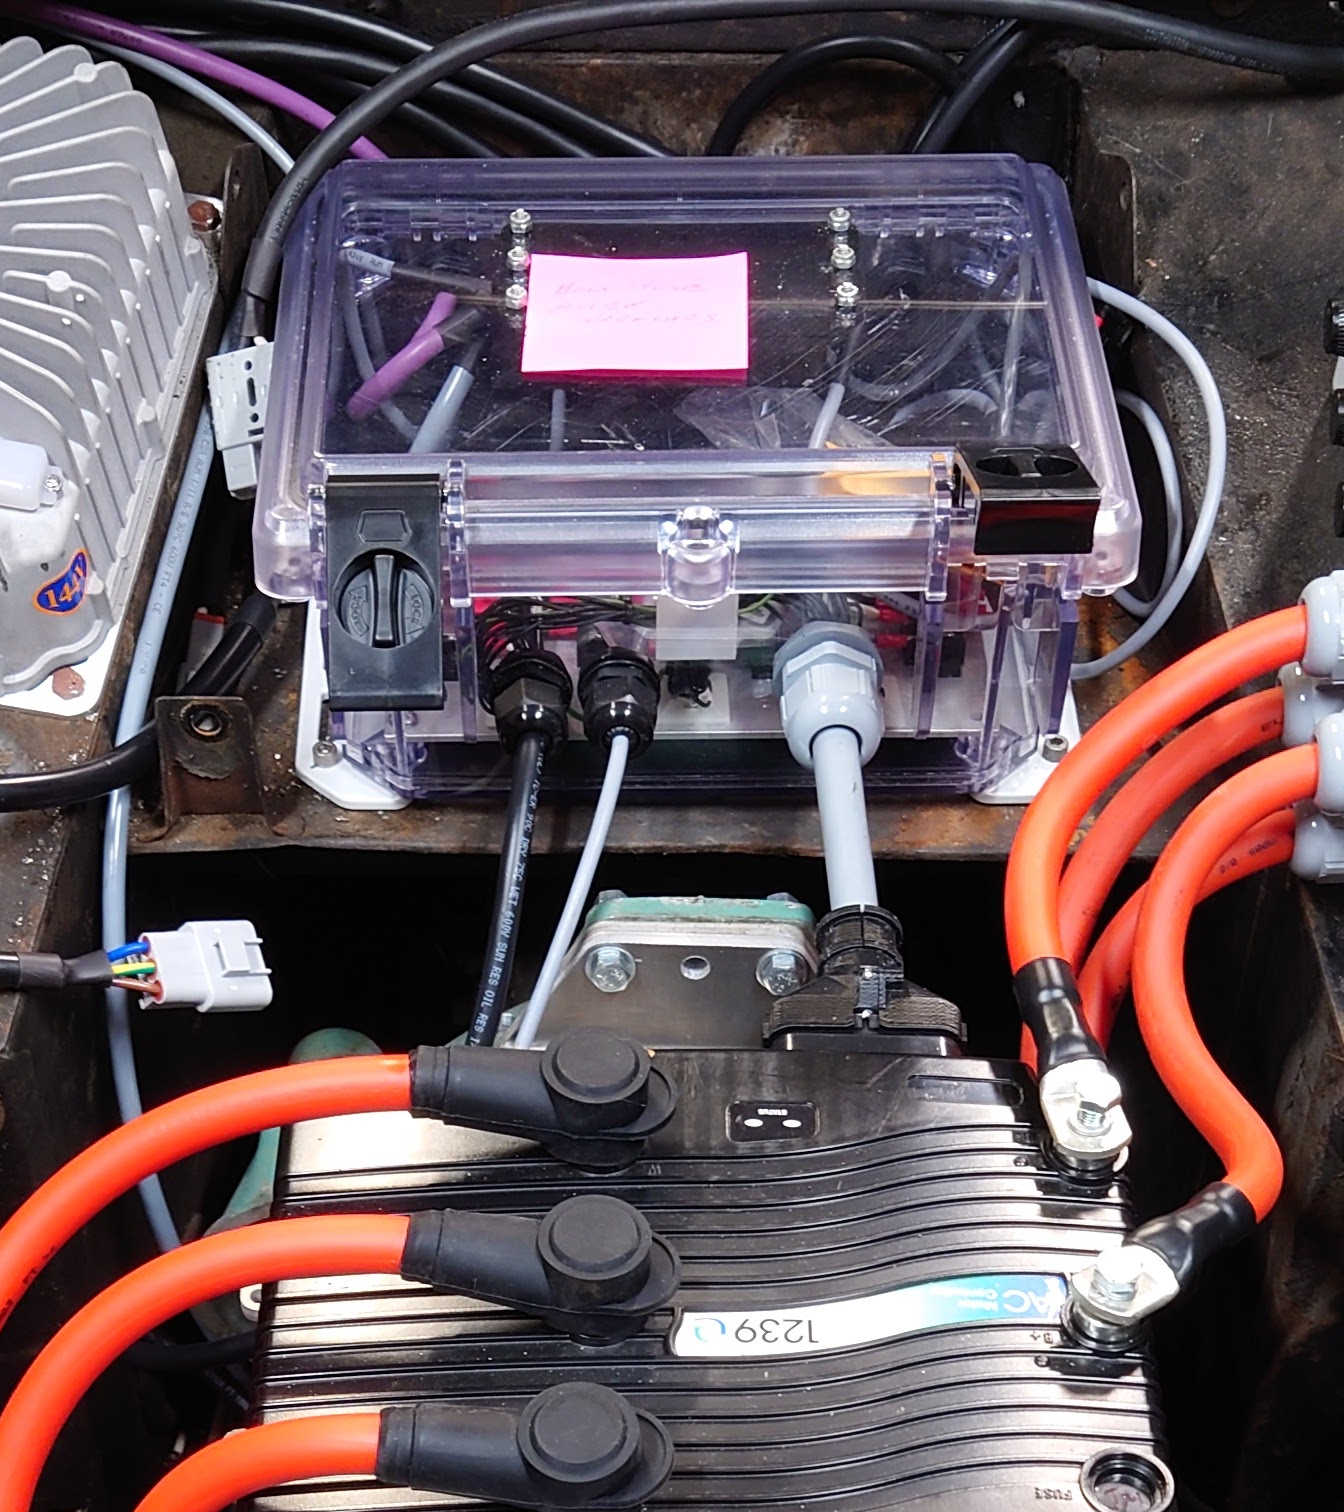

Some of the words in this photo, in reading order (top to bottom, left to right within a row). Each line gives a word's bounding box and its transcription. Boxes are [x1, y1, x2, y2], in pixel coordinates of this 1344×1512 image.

[519, 836, 532, 857] DRY
[514, 862, 527, 882] 75C
[510, 886, 523, 908] WET
[502, 909, 516, 939] 600V
[495, 940, 508, 962] SUN
[489, 964, 502, 986] RES
[481, 989, 494, 1011] OIL
[474, 1012, 488, 1035] RES
[1002, 1289, 1049, 1314] AC
[734, 1317, 820, 1344] 1239
